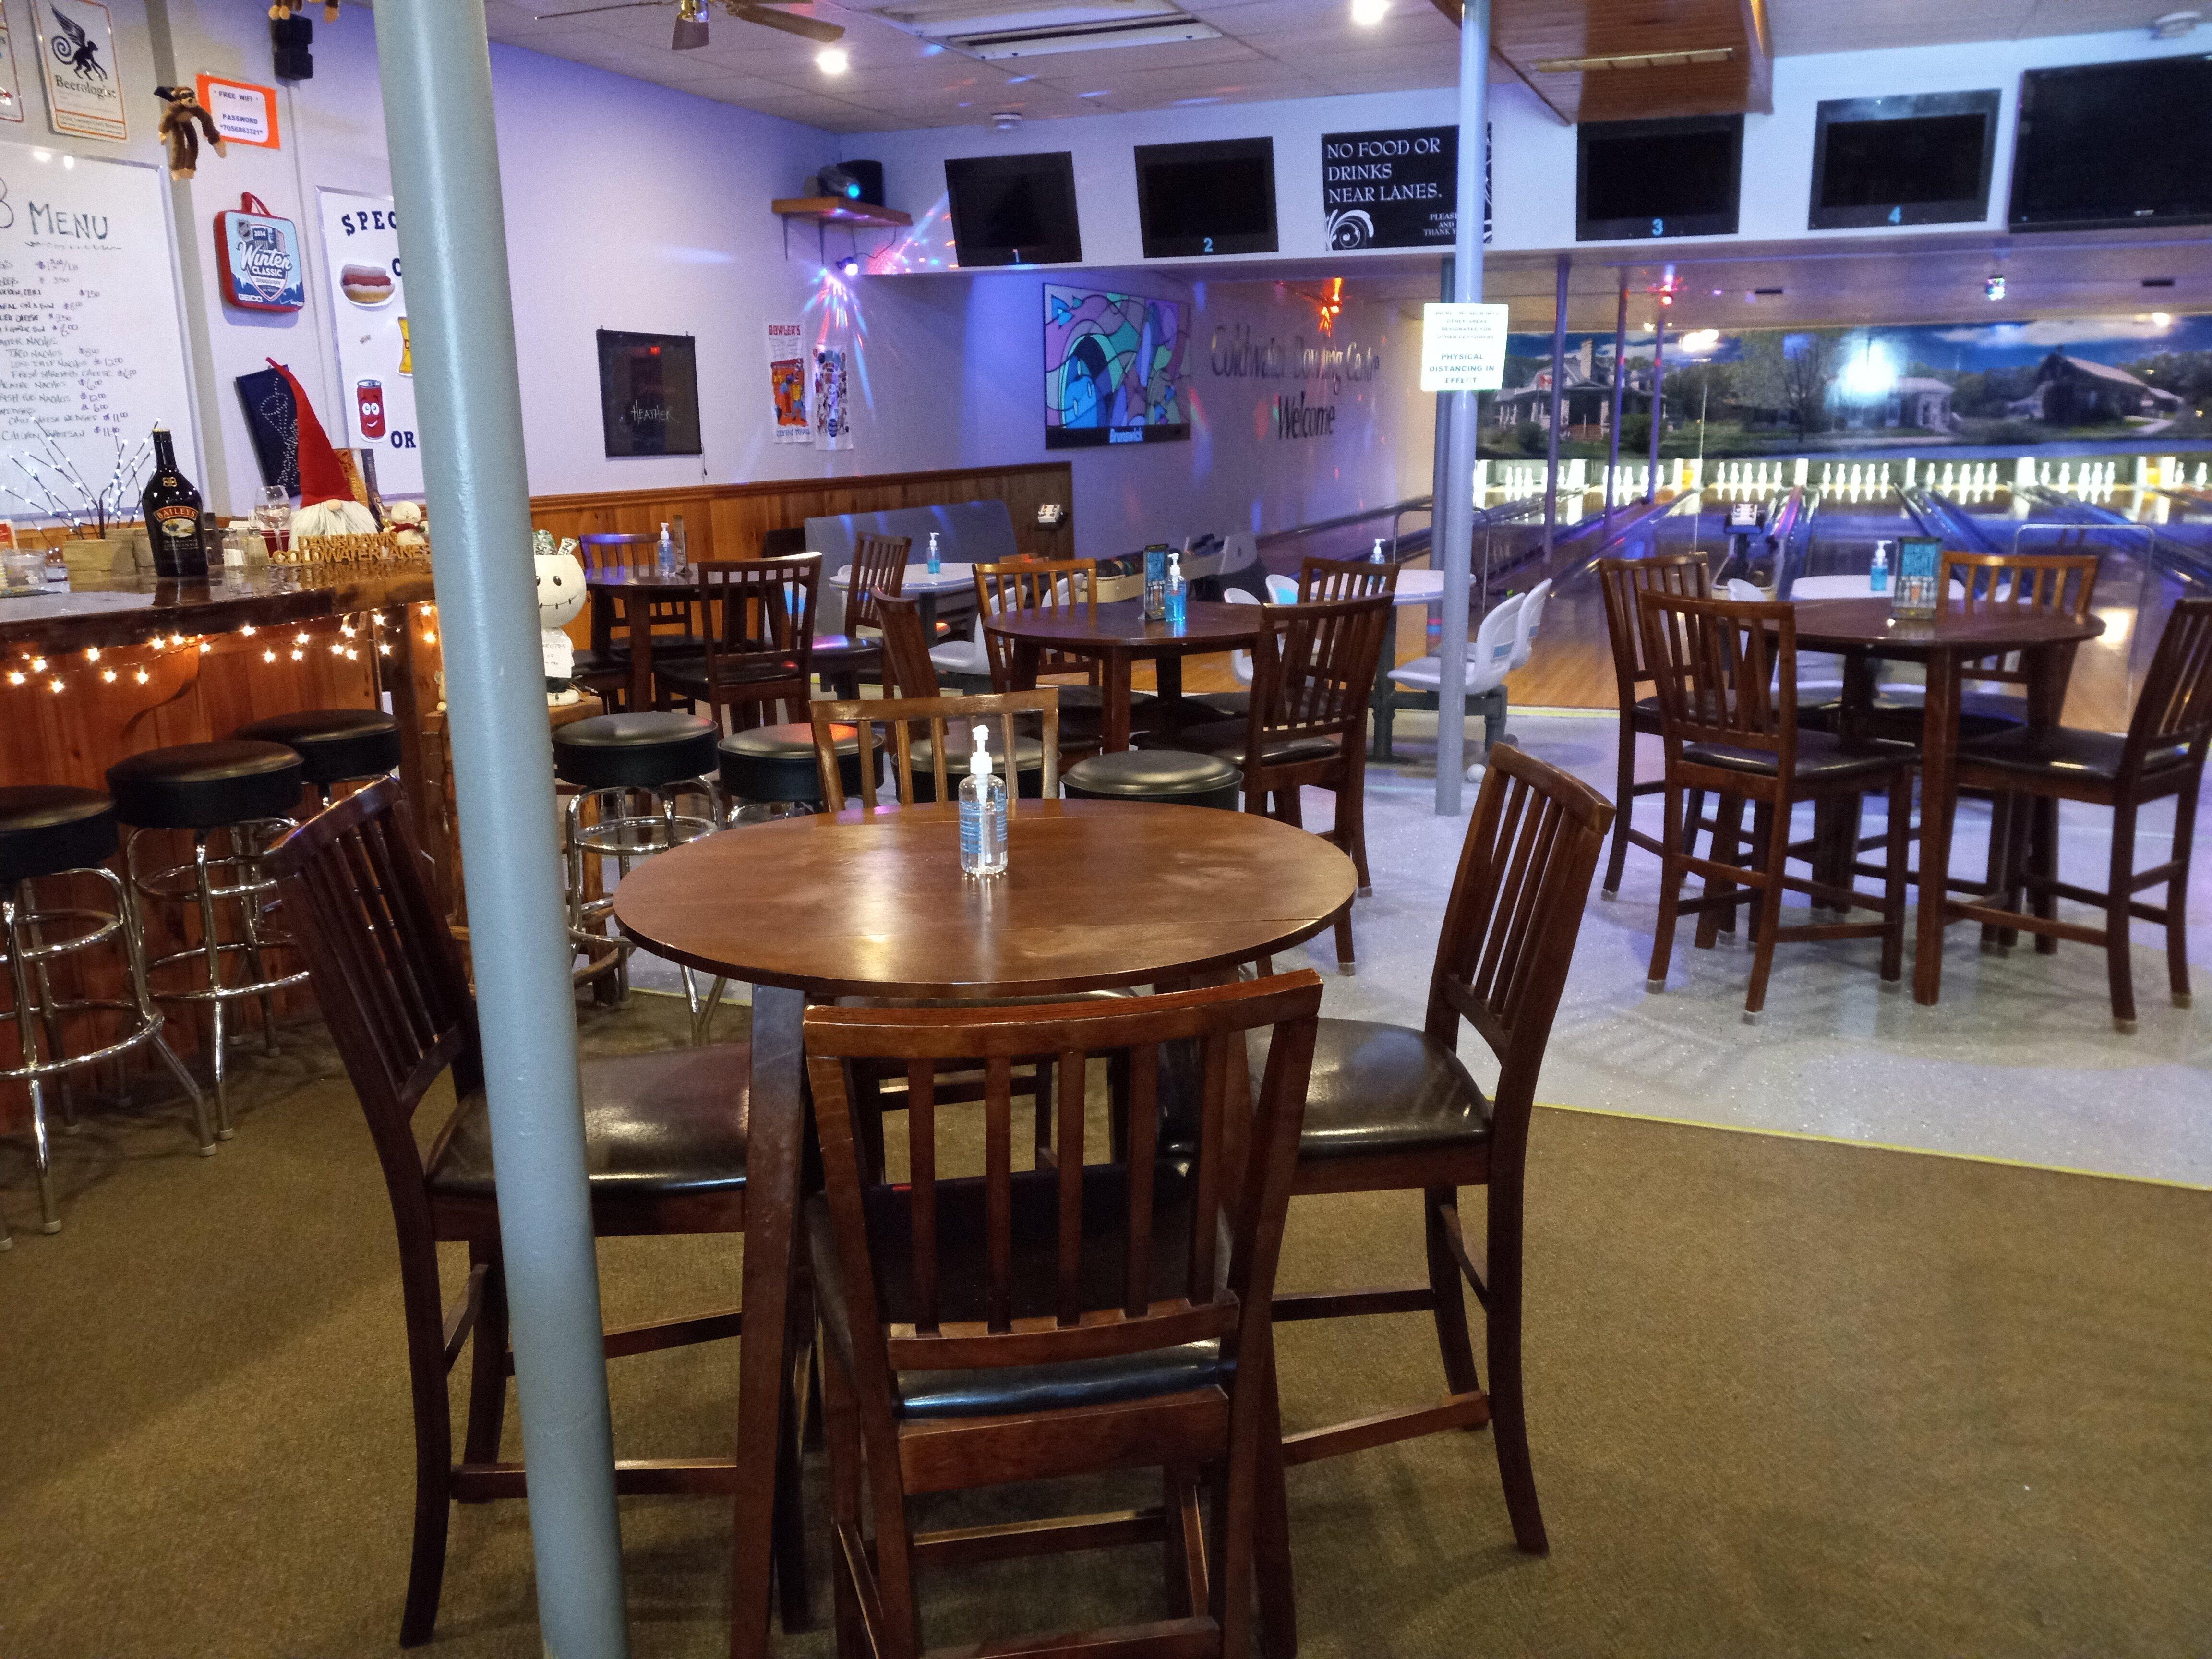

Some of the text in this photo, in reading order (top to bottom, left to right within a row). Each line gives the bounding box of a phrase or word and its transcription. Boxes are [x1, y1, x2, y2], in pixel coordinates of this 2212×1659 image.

[54, 75, 116, 99] Beerologist
[219, 91, 236, 99] FREE
[223, 114, 258, 124] PASSWORD
[1327, 137, 1440, 158] NO FOOD OR
[1328, 163, 1392, 181] DRINKS
[1329, 183, 1442, 203] NEAR LANES.
[28, 201, 108, 240] MENU
[1888, 206, 1901, 223] 4
[1652, 218, 1663, 235] 3
[1204, 237, 1213, 252] 2
[236, 240, 292, 271] Winter
[1013, 249, 1019, 262] 1
[252, 266, 283, 277] CLASSIC
[238, 293, 264, 303] GEICO
[630, 399, 680, 424] HEATHER
[1278, 390, 1335, 440] Welcome
[391, 431, 416, 448] OR
[156, 508, 196, 518] BAILEYS
